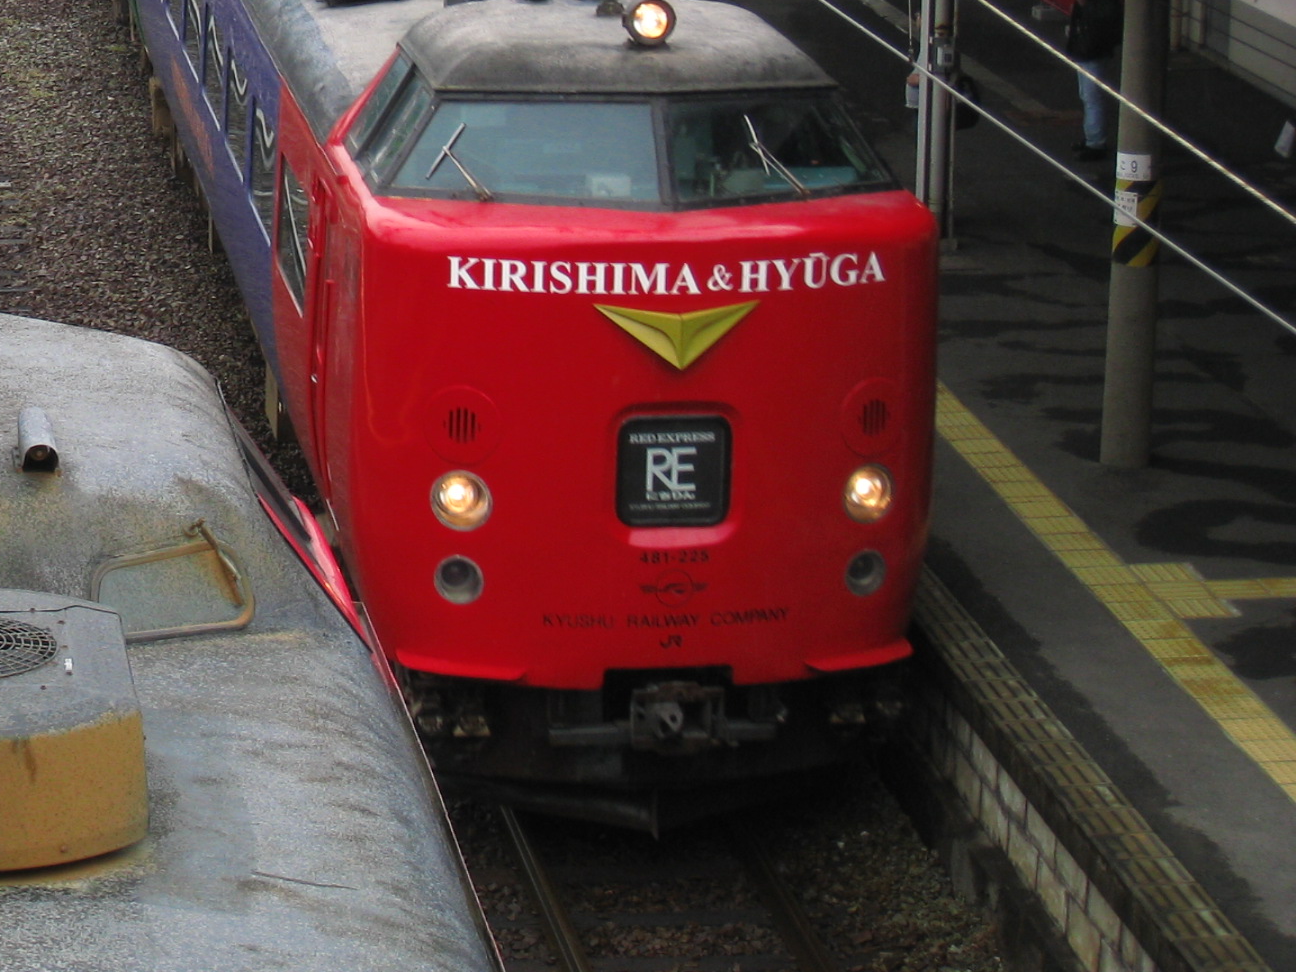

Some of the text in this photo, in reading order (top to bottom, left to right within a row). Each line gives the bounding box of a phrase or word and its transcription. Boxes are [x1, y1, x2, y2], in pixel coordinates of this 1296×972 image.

[446, 255, 702, 295] KIRISHIMA
[706, 264, 734, 292] &
[629, 431, 716, 444] RED EXPRESS
[646, 446, 697, 492] RE
[542, 607, 790, 628] KYUSHU RAILWAY COMPANY
